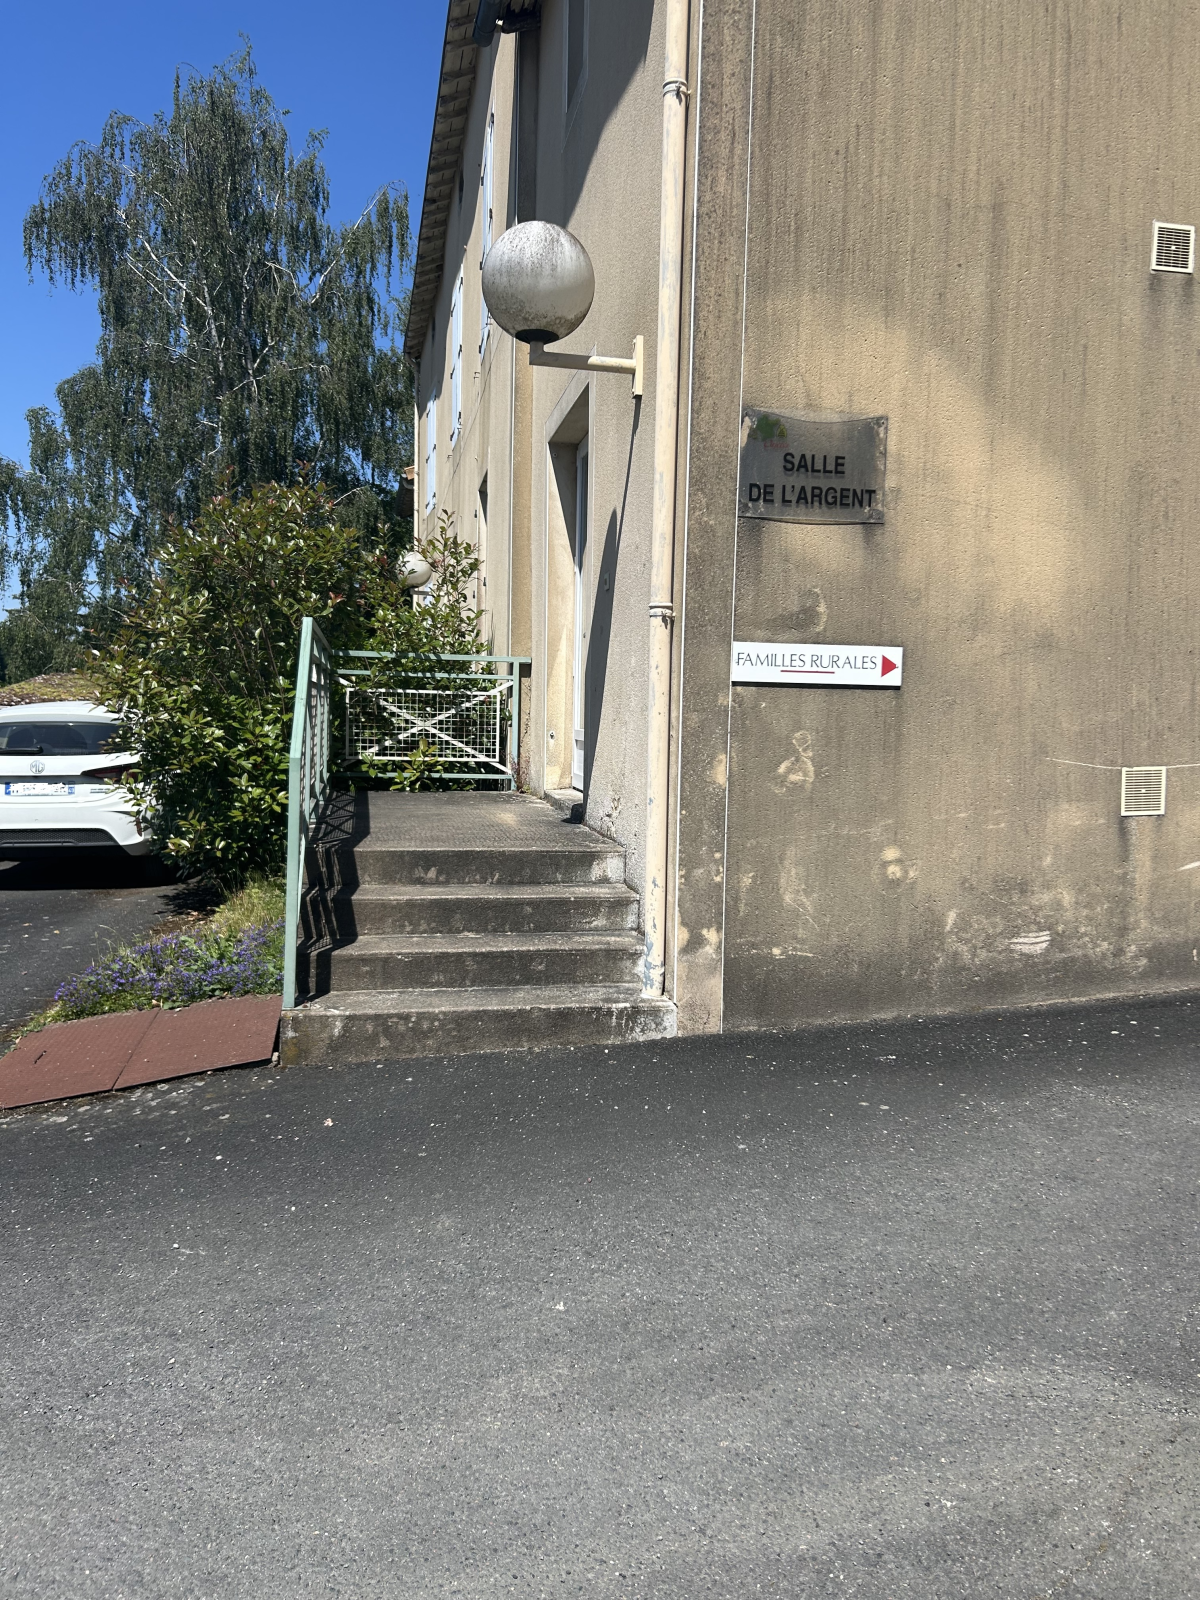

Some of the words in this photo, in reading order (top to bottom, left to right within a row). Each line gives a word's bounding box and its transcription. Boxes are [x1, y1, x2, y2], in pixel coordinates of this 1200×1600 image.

[783, 452, 846, 474] SALLE
[748, 483, 775, 503] DE
[781, 484, 876, 508] L'ARGENT
[736, 652, 806, 668] FAMILLES
[810, 654, 877, 669] RURALES
[30, 760, 45, 774] MG
